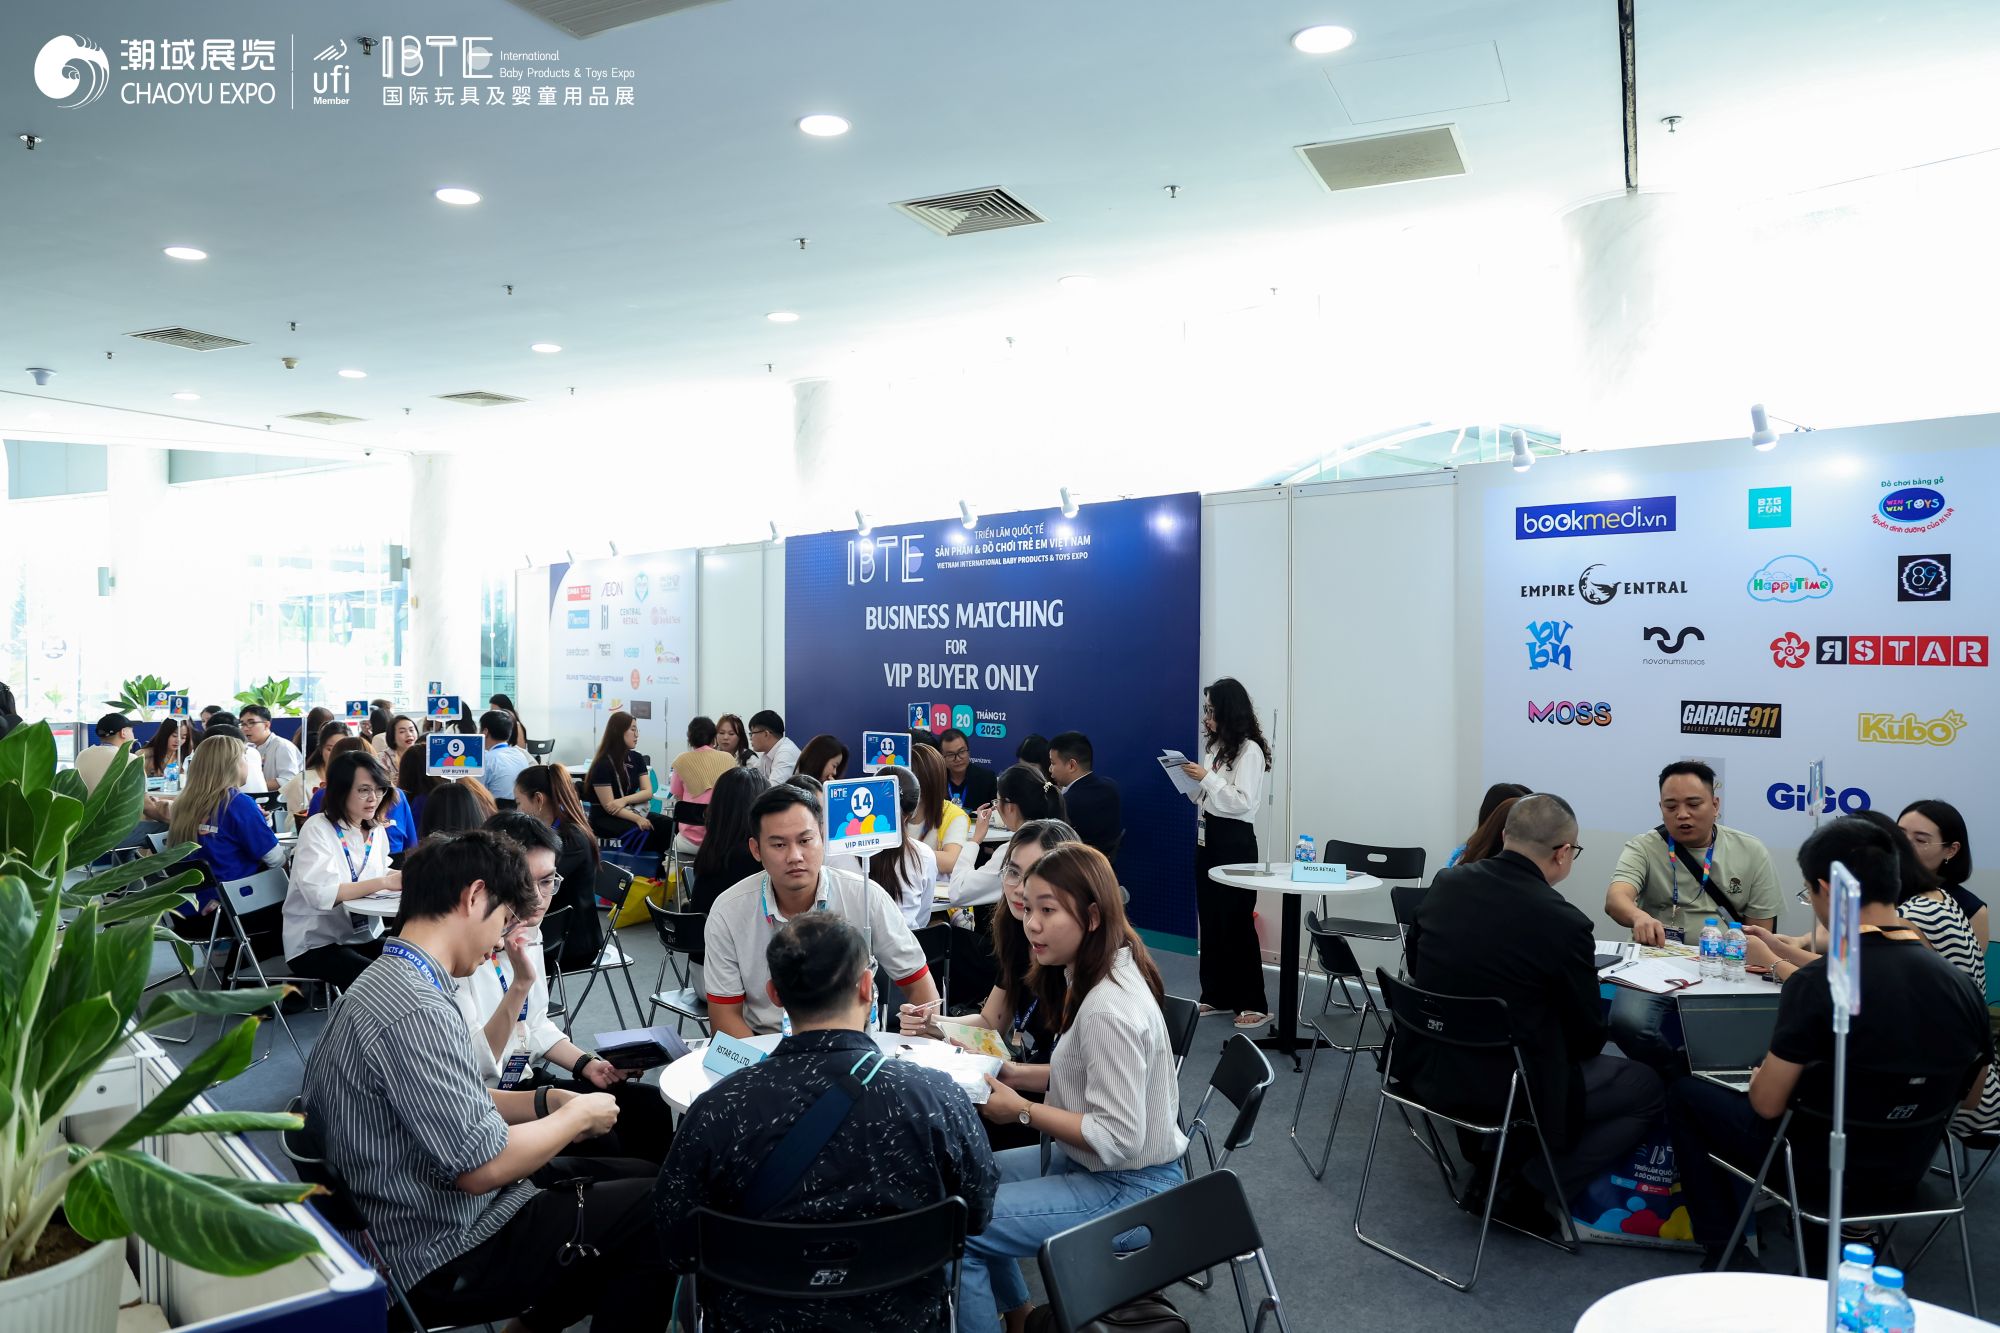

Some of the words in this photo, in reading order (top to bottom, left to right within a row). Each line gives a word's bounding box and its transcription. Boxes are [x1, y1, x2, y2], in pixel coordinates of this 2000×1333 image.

[1757, 497, 1782, 506] BIG
[1757, 505, 1782, 514] FUN
[1523, 505, 1667, 534] bookmedi.vn
[996, 526, 1011, 538] LÃM
[1011, 524, 1033, 538] QUỐC
[1034, 522, 1045, 535] TẾ
[974, 544, 981, 554] &
[1035, 539, 1048, 550] EM
[1070, 535, 1091, 547] NAM
[936, 561, 960, 570] VIETNAM
[960, 558, 1002, 568] INTERNATIONAL
[1002, 557, 1017, 565] BABY
[1017, 555, 1049, 564] PRODUCTS
[1055, 552, 1071, 561] TOYS
[1071, 551, 1089, 560] EXPO
[1520, 584, 1575, 598] EMPIRE
[865, 603, 950, 631] BUSINESS
[955, 599, 1064, 629] MATCHING
[945, 639, 968, 655] FOR
[883, 663, 913, 688] VIP
[917, 663, 979, 690] BUYER
[984, 664, 1040, 692] ONLY
[934, 712, 948, 727] 19
[956, 713, 971, 728] 20
[1528, 700, 1613, 727] MOSS
[980, 725, 1002, 736] 2025
[1859, 711, 1956, 745] Kubo
[452, 742, 460, 752] 9
[882, 741, 893, 751] 11
[853, 792, 872, 811] 14
[845, 841, 857, 849] VIP
[857, 838, 880, 847] BUYER
[404, 951, 423, 966] TOYS
[420, 964, 435, 984] EXPO
[716, 1044, 732, 1059] RSTAR
